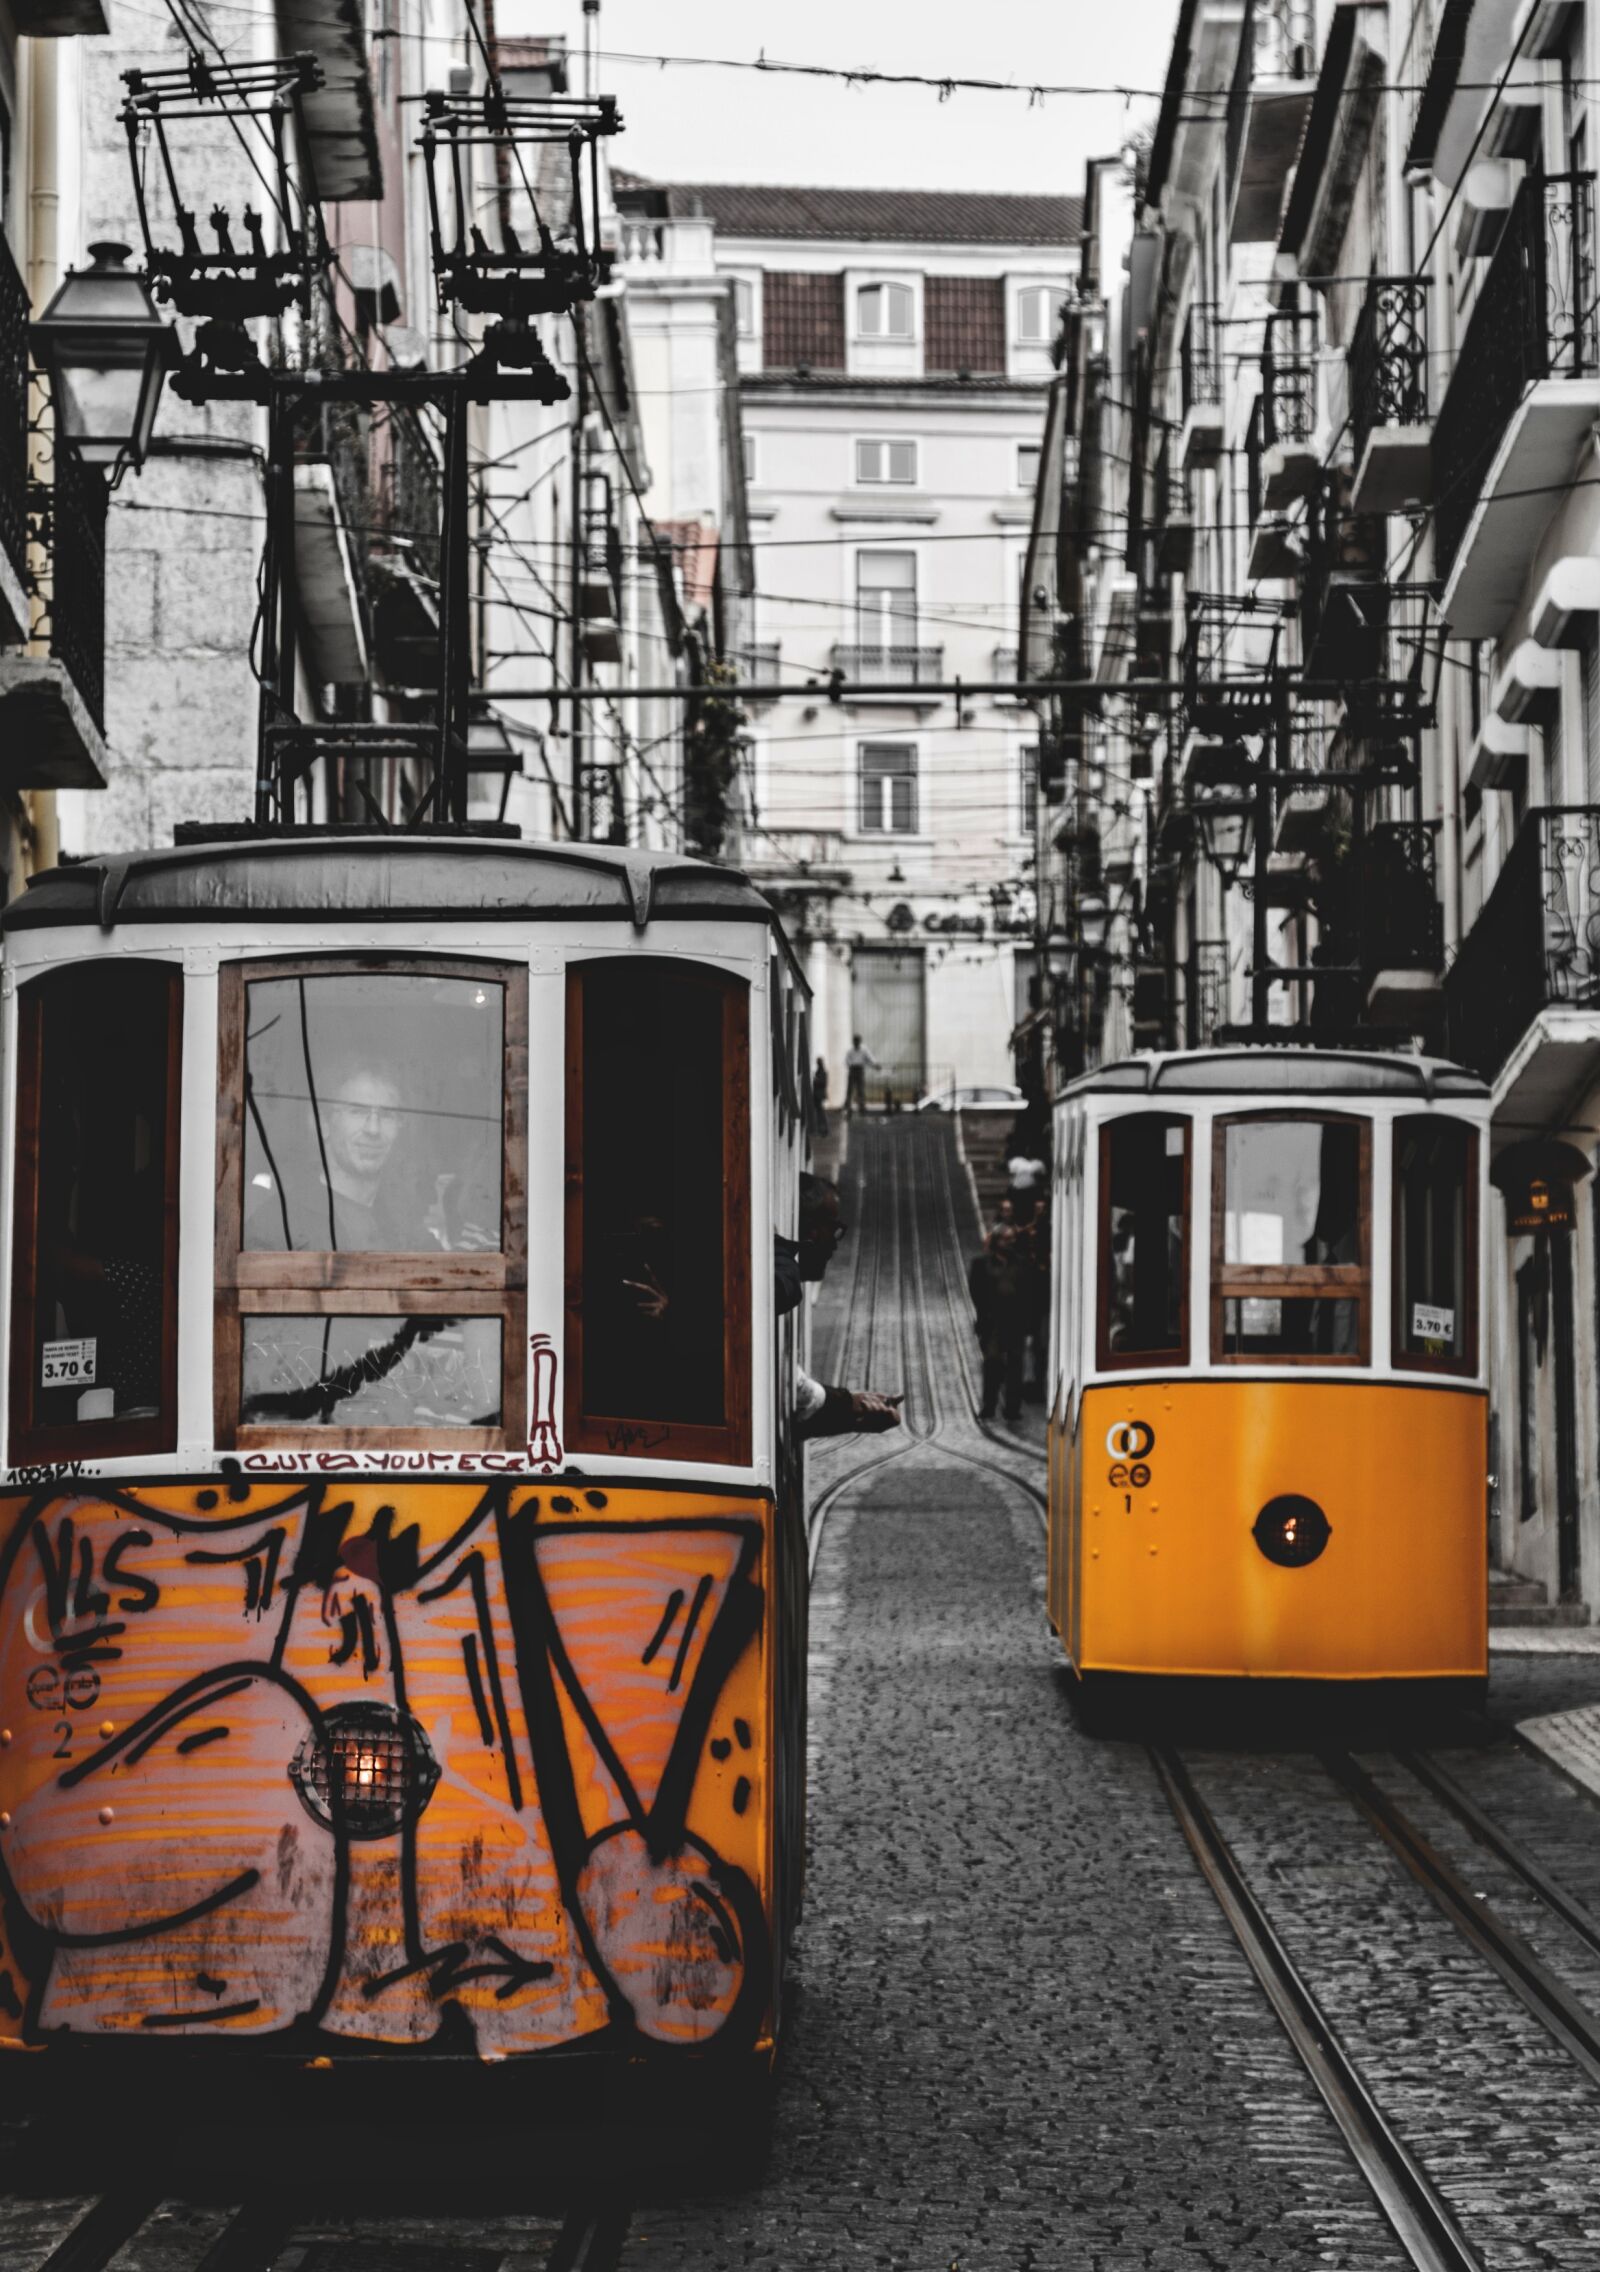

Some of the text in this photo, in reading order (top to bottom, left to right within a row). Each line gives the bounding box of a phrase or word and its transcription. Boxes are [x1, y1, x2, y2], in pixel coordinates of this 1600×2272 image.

[1416, 1319, 1441, 1333] 3.70
[45, 1360, 93, 1378] 3.70 €
[53, 1721, 73, 1758] 2
